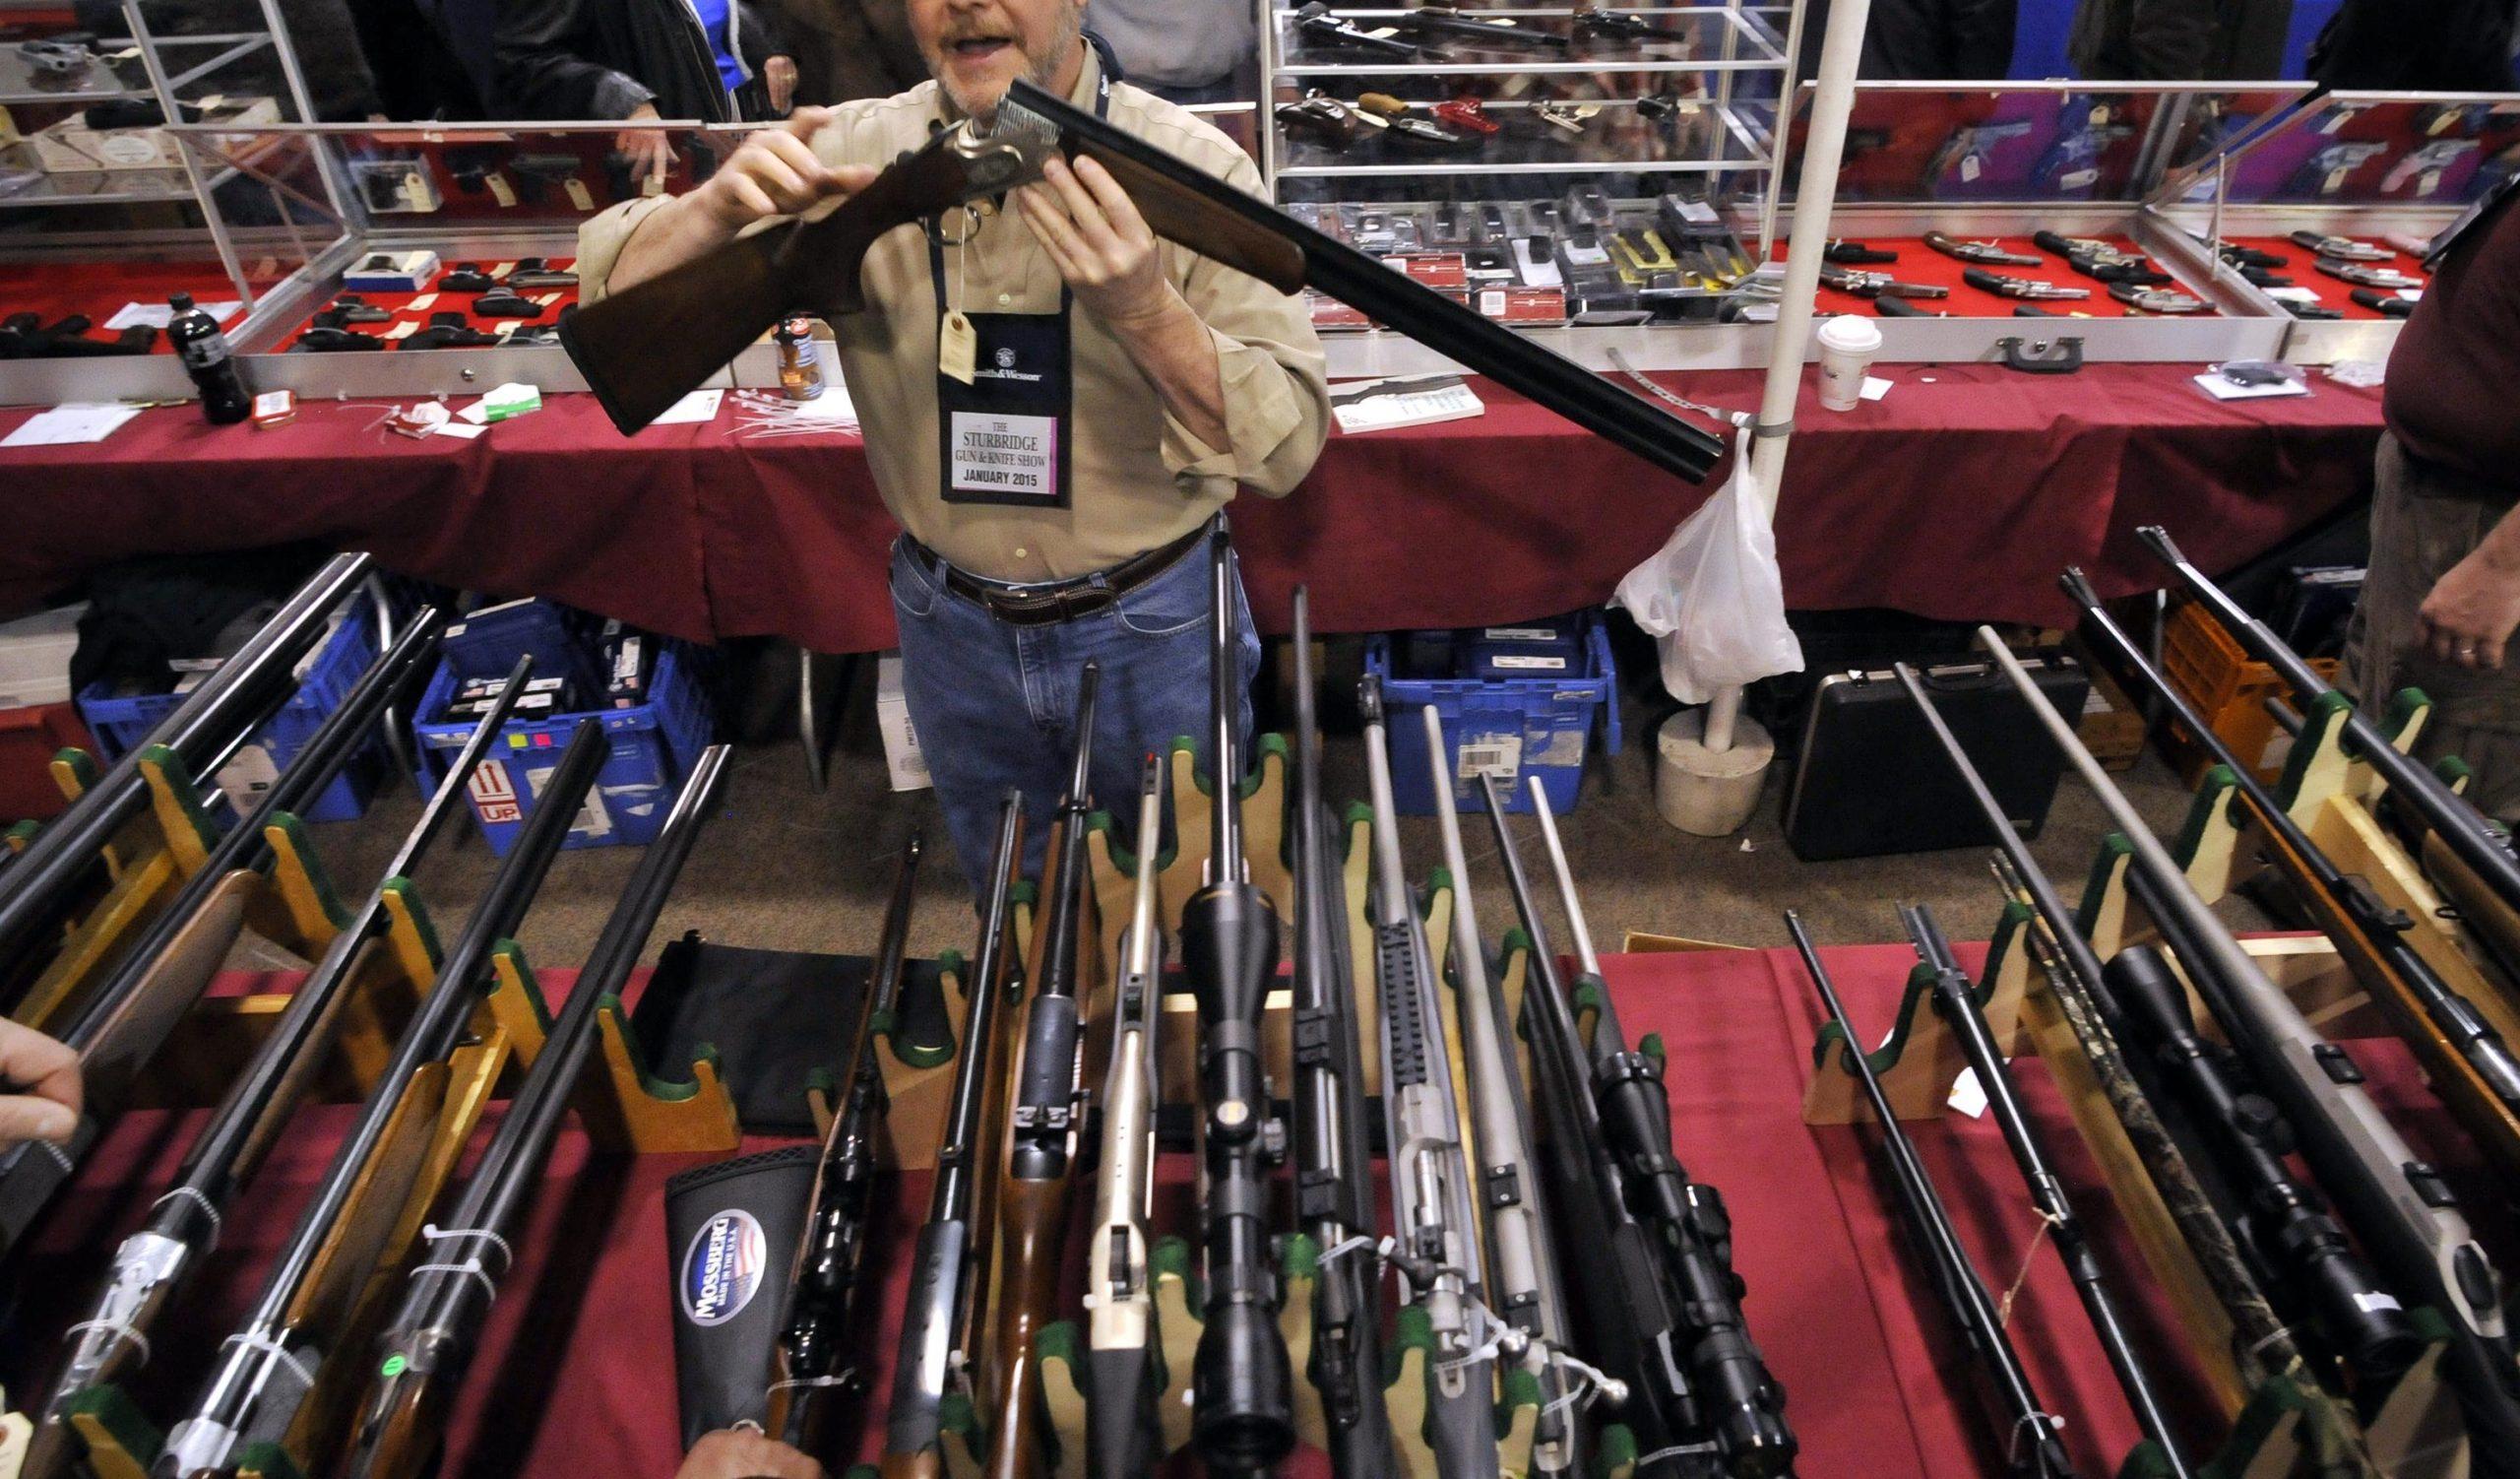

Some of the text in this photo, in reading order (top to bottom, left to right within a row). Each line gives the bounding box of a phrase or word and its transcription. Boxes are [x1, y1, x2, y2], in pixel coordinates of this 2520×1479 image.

[992, 422, 1008, 432] THE
[964, 432, 1039, 451] STURBRIDGE
[955, 450, 1045, 468] GUN & KNIFE SHOW
[964, 470, 1038, 486] JANUARY 2015
[483, 806, 516, 820] UP
[695, 1218, 729, 1318] MOSSBERG
